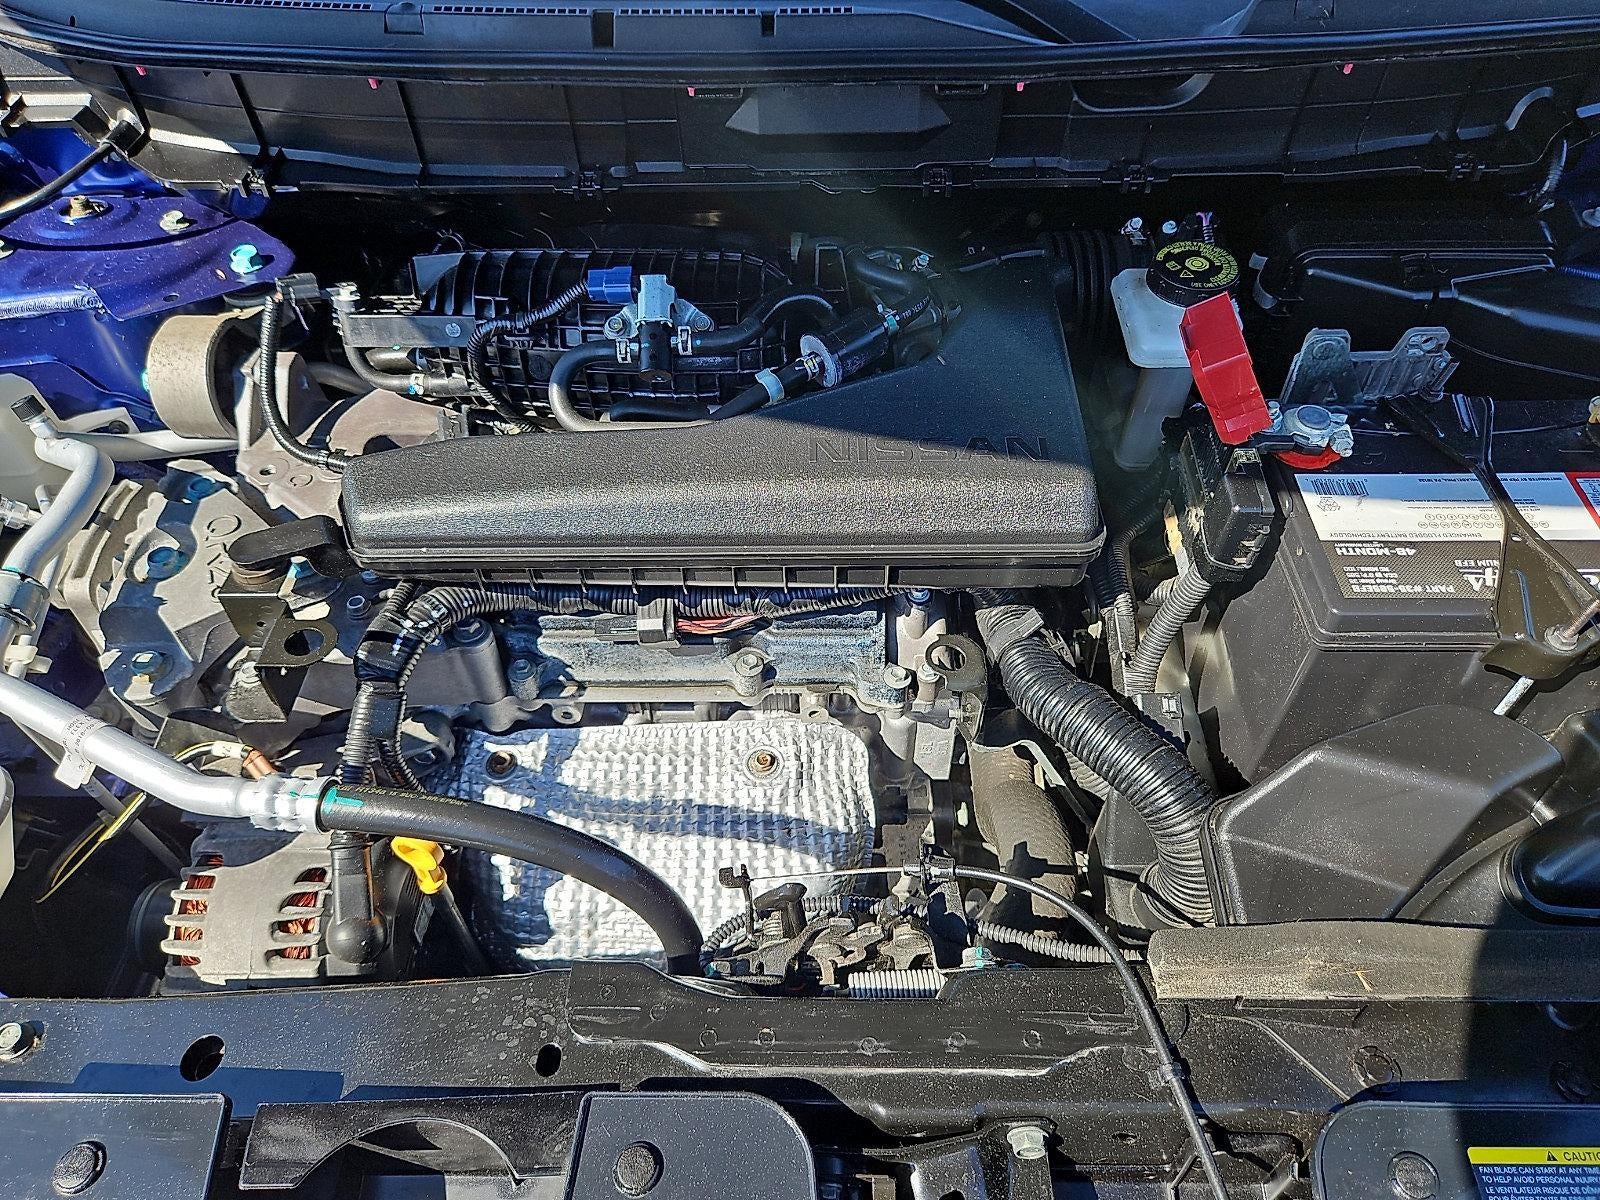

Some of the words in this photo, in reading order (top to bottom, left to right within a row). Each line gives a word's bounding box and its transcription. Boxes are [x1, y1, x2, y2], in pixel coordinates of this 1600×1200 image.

[809, 436, 1052, 463] NISSAN
[1336, 546, 1417, 556] 48-MONTH
[1455, 559, 1475, 568] EFB
[1425, 584, 1455, 593] PART
[1478, 1166, 1493, 1174] FAN
[1494, 1166, 1518, 1174] BLADE
[1518, 1166, 1534, 1174] CAN
[1535, 1166, 1557, 1174] START
[1558, 1166, 1567, 1174] AT
[1568, 1166, 1582, 1174] ANY
[1481, 1175, 1493, 1183] TO
[1493, 1175, 1512, 1183] HELP
[1513, 1175, 1535, 1184] AVOID
[1535, 1175, 1575, 1184] PERSONAL
[1485, 1186, 1495, 1194] LE
[1495, 1186, 1541, 1194] VENTILATEUR
[1541, 1186, 1570, 1195] RISQUE
[1570, 1186, 1581, 1194] DE
